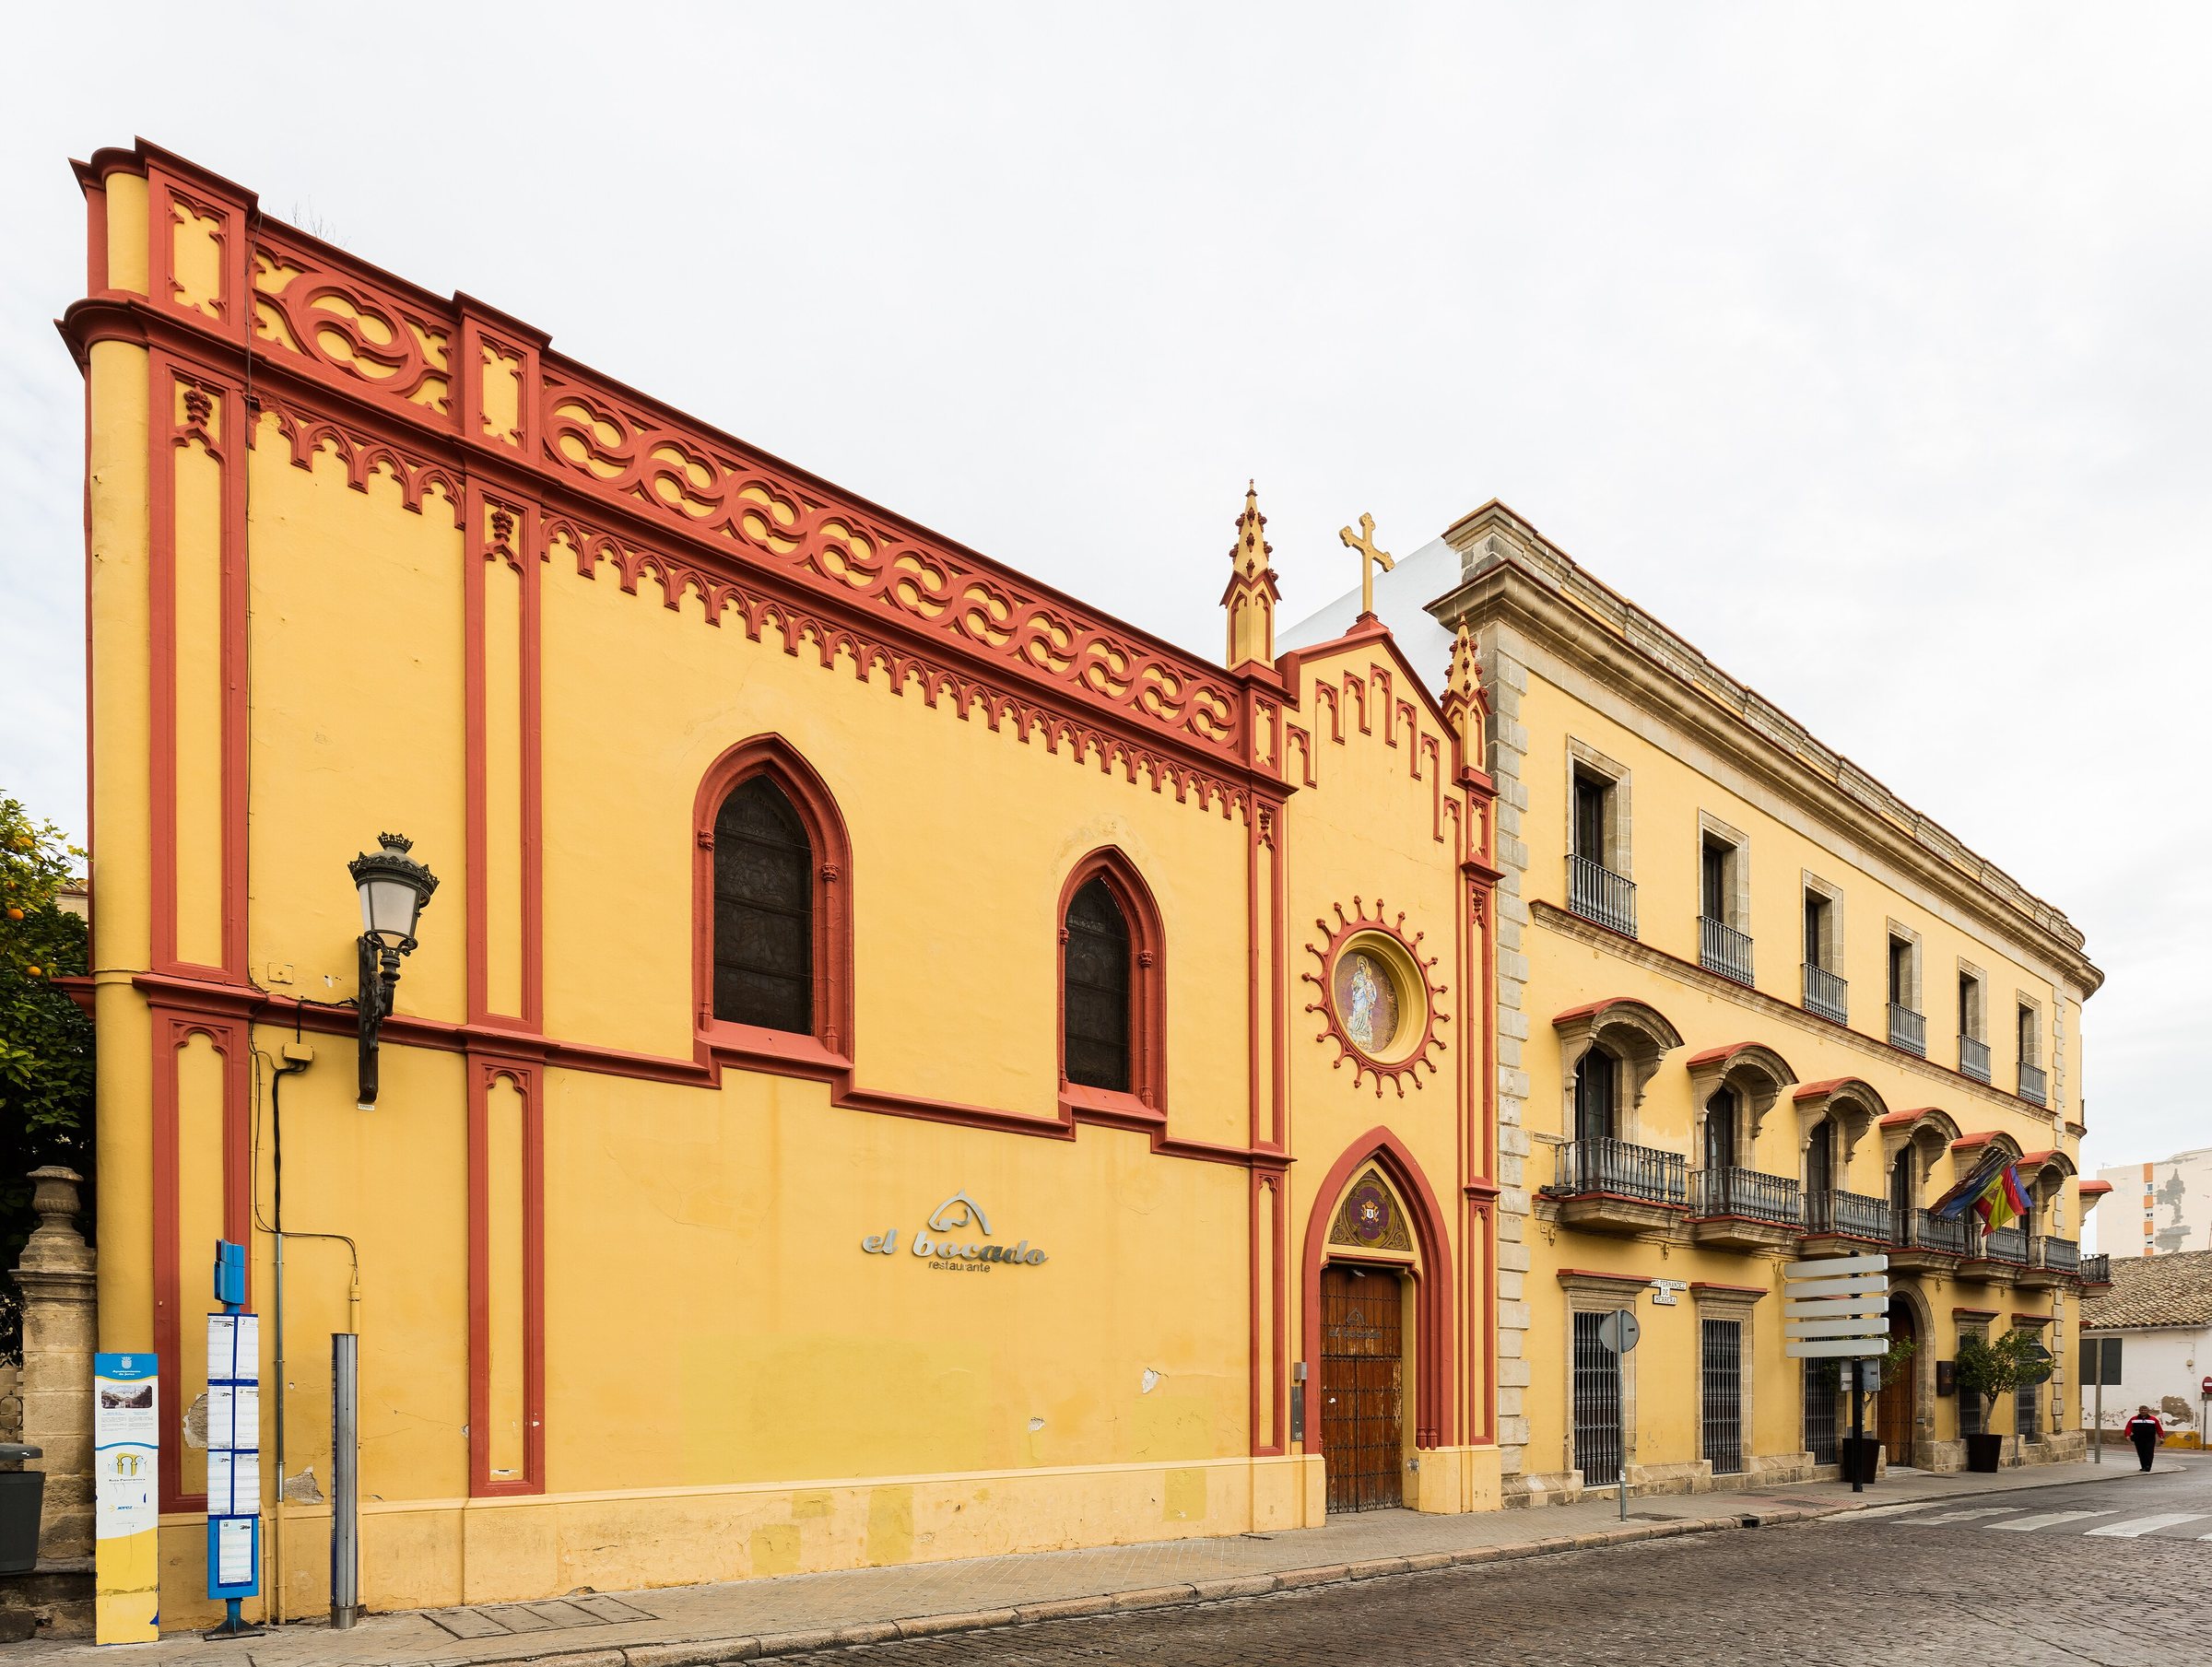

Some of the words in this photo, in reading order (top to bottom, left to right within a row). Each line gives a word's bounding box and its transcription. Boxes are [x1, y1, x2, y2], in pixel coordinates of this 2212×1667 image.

[861, 1228, 899, 1255] el
[912, 1230, 1049, 1266] bocado
[927, 1260, 992, 1274] restaurante
